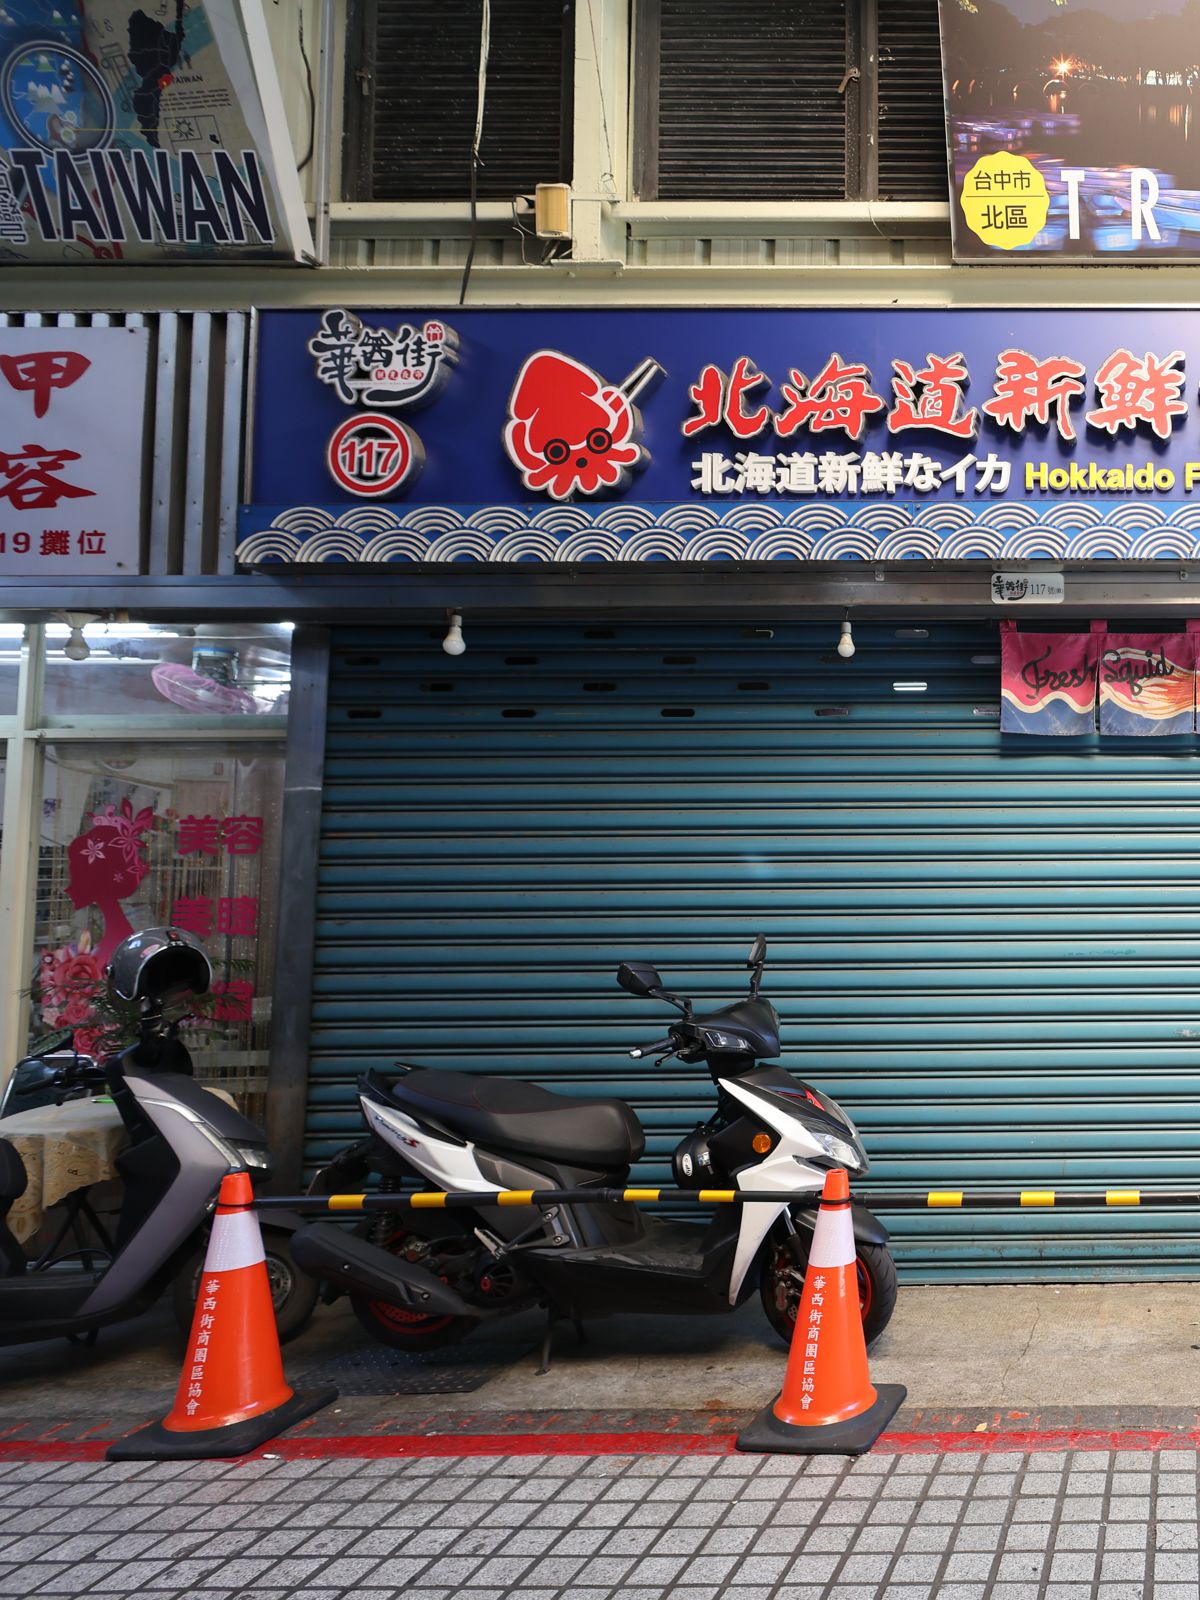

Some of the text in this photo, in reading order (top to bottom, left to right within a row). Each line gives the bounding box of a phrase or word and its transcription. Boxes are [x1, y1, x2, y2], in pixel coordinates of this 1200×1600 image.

[9, 149, 273, 241] TAIWAN
[974, 170, 1031, 190] 台中市
[981, 205, 1028, 230] 北區
[311, 310, 443, 402] 華西街
[0, 351, 92, 419] 甲
[341, 440, 400, 474] 117
[691, 451, 1012, 494] 北海道新鮮なイカ
[1025, 462, 1175, 491] Hokkaido
[1030, 584, 1046, 595] 117
[1022, 646, 1175, 699] Fresh Squid
[177, 814, 264, 855] 美容
